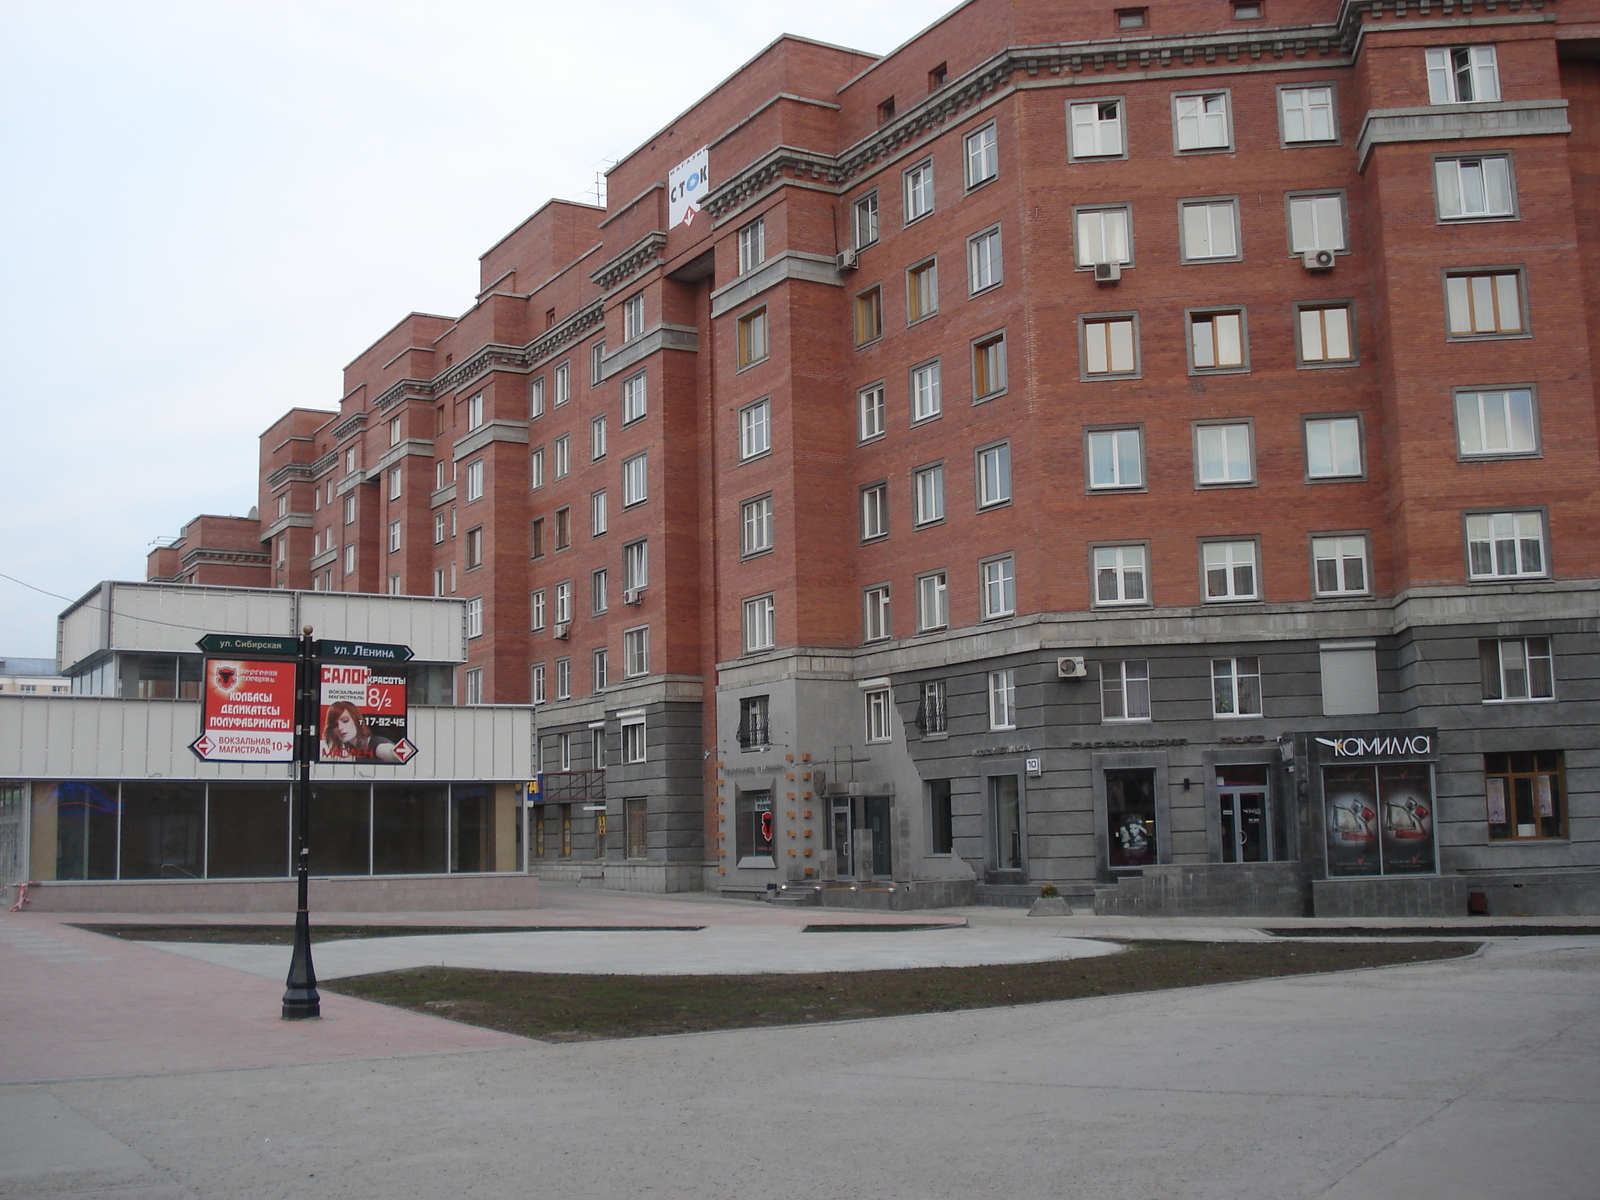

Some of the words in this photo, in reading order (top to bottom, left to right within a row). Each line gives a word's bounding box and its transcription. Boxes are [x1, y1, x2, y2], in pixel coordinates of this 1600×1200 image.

[670, 165, 707, 203] СТОК
[219, 640, 233, 649] ул.
[235, 640, 282, 650] Сибирская
[321, 667, 372, 685] САЛОН
[367, 676, 406, 685] КРАСОТЫ
[229, 691, 273, 703] КОЛБАСЫ
[368, 688, 392, 712] 8/2
[220, 704, 280, 716] ДЕЛИКАТЕСЫ
[210, 716, 290, 729] ПОЛУФАБРИКАТЫ
[218, 736, 271, 746] ВОКЗАЛЬНАЯ
[271, 741, 283, 751] 10
[218, 745, 271, 755] МАГИСТРАЛЬ
[1028, 760, 1037, 769] 10
